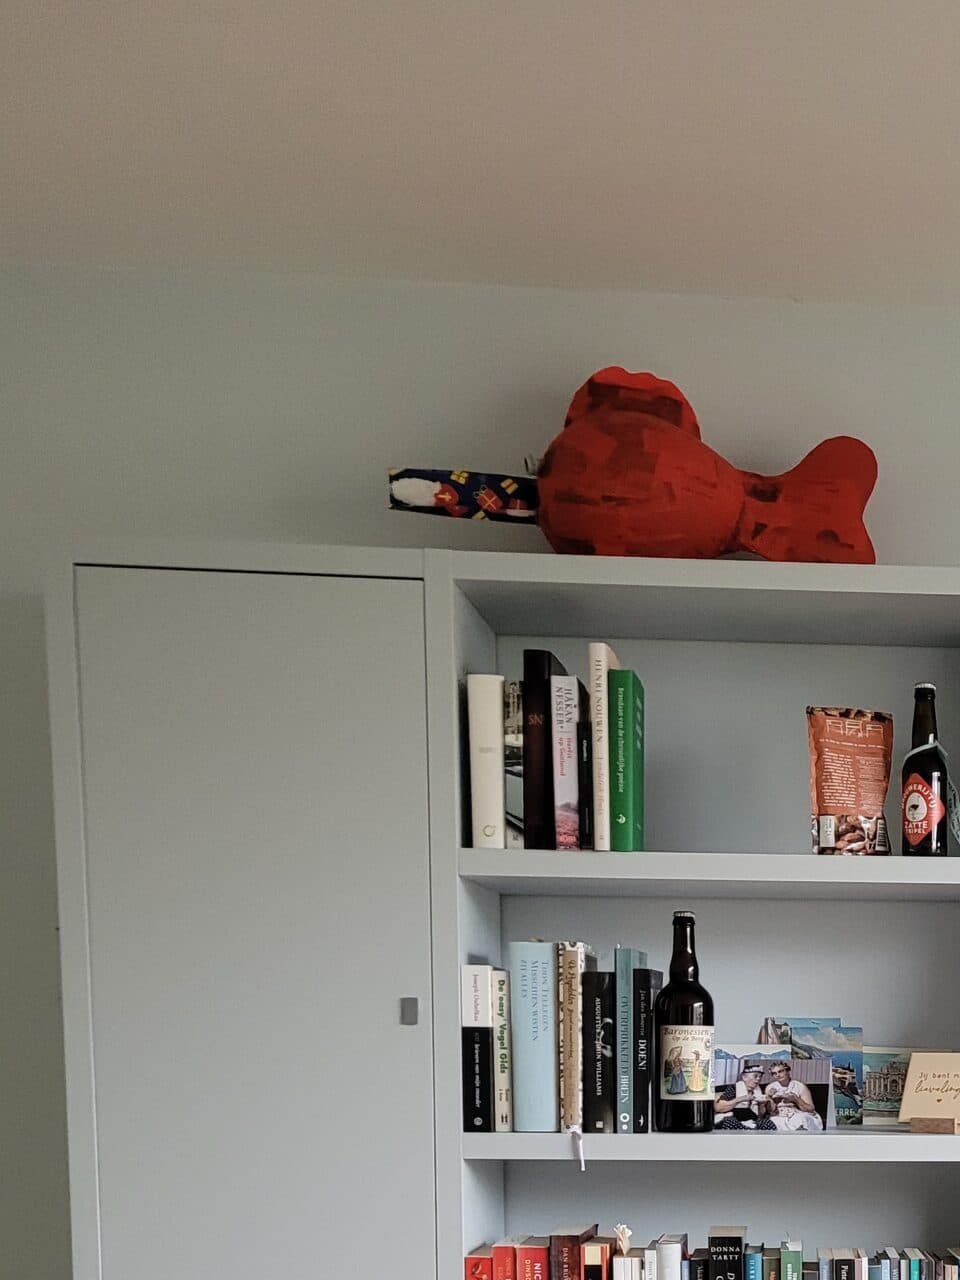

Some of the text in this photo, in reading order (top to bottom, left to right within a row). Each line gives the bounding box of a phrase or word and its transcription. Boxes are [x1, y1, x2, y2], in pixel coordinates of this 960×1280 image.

[555, 687, 565, 724] NESSER
[594, 659, 605, 743] HENRI NOUWEN
[498, 979, 506, 991] De
[498, 1024, 507, 1050] Vogel
[500, 1053, 508, 1074] Gids
[638, 1039, 648, 1071] DOEN!
[620, 1075, 630, 1103] BREIN
[836, 1109, 855, 1117] ERRE
